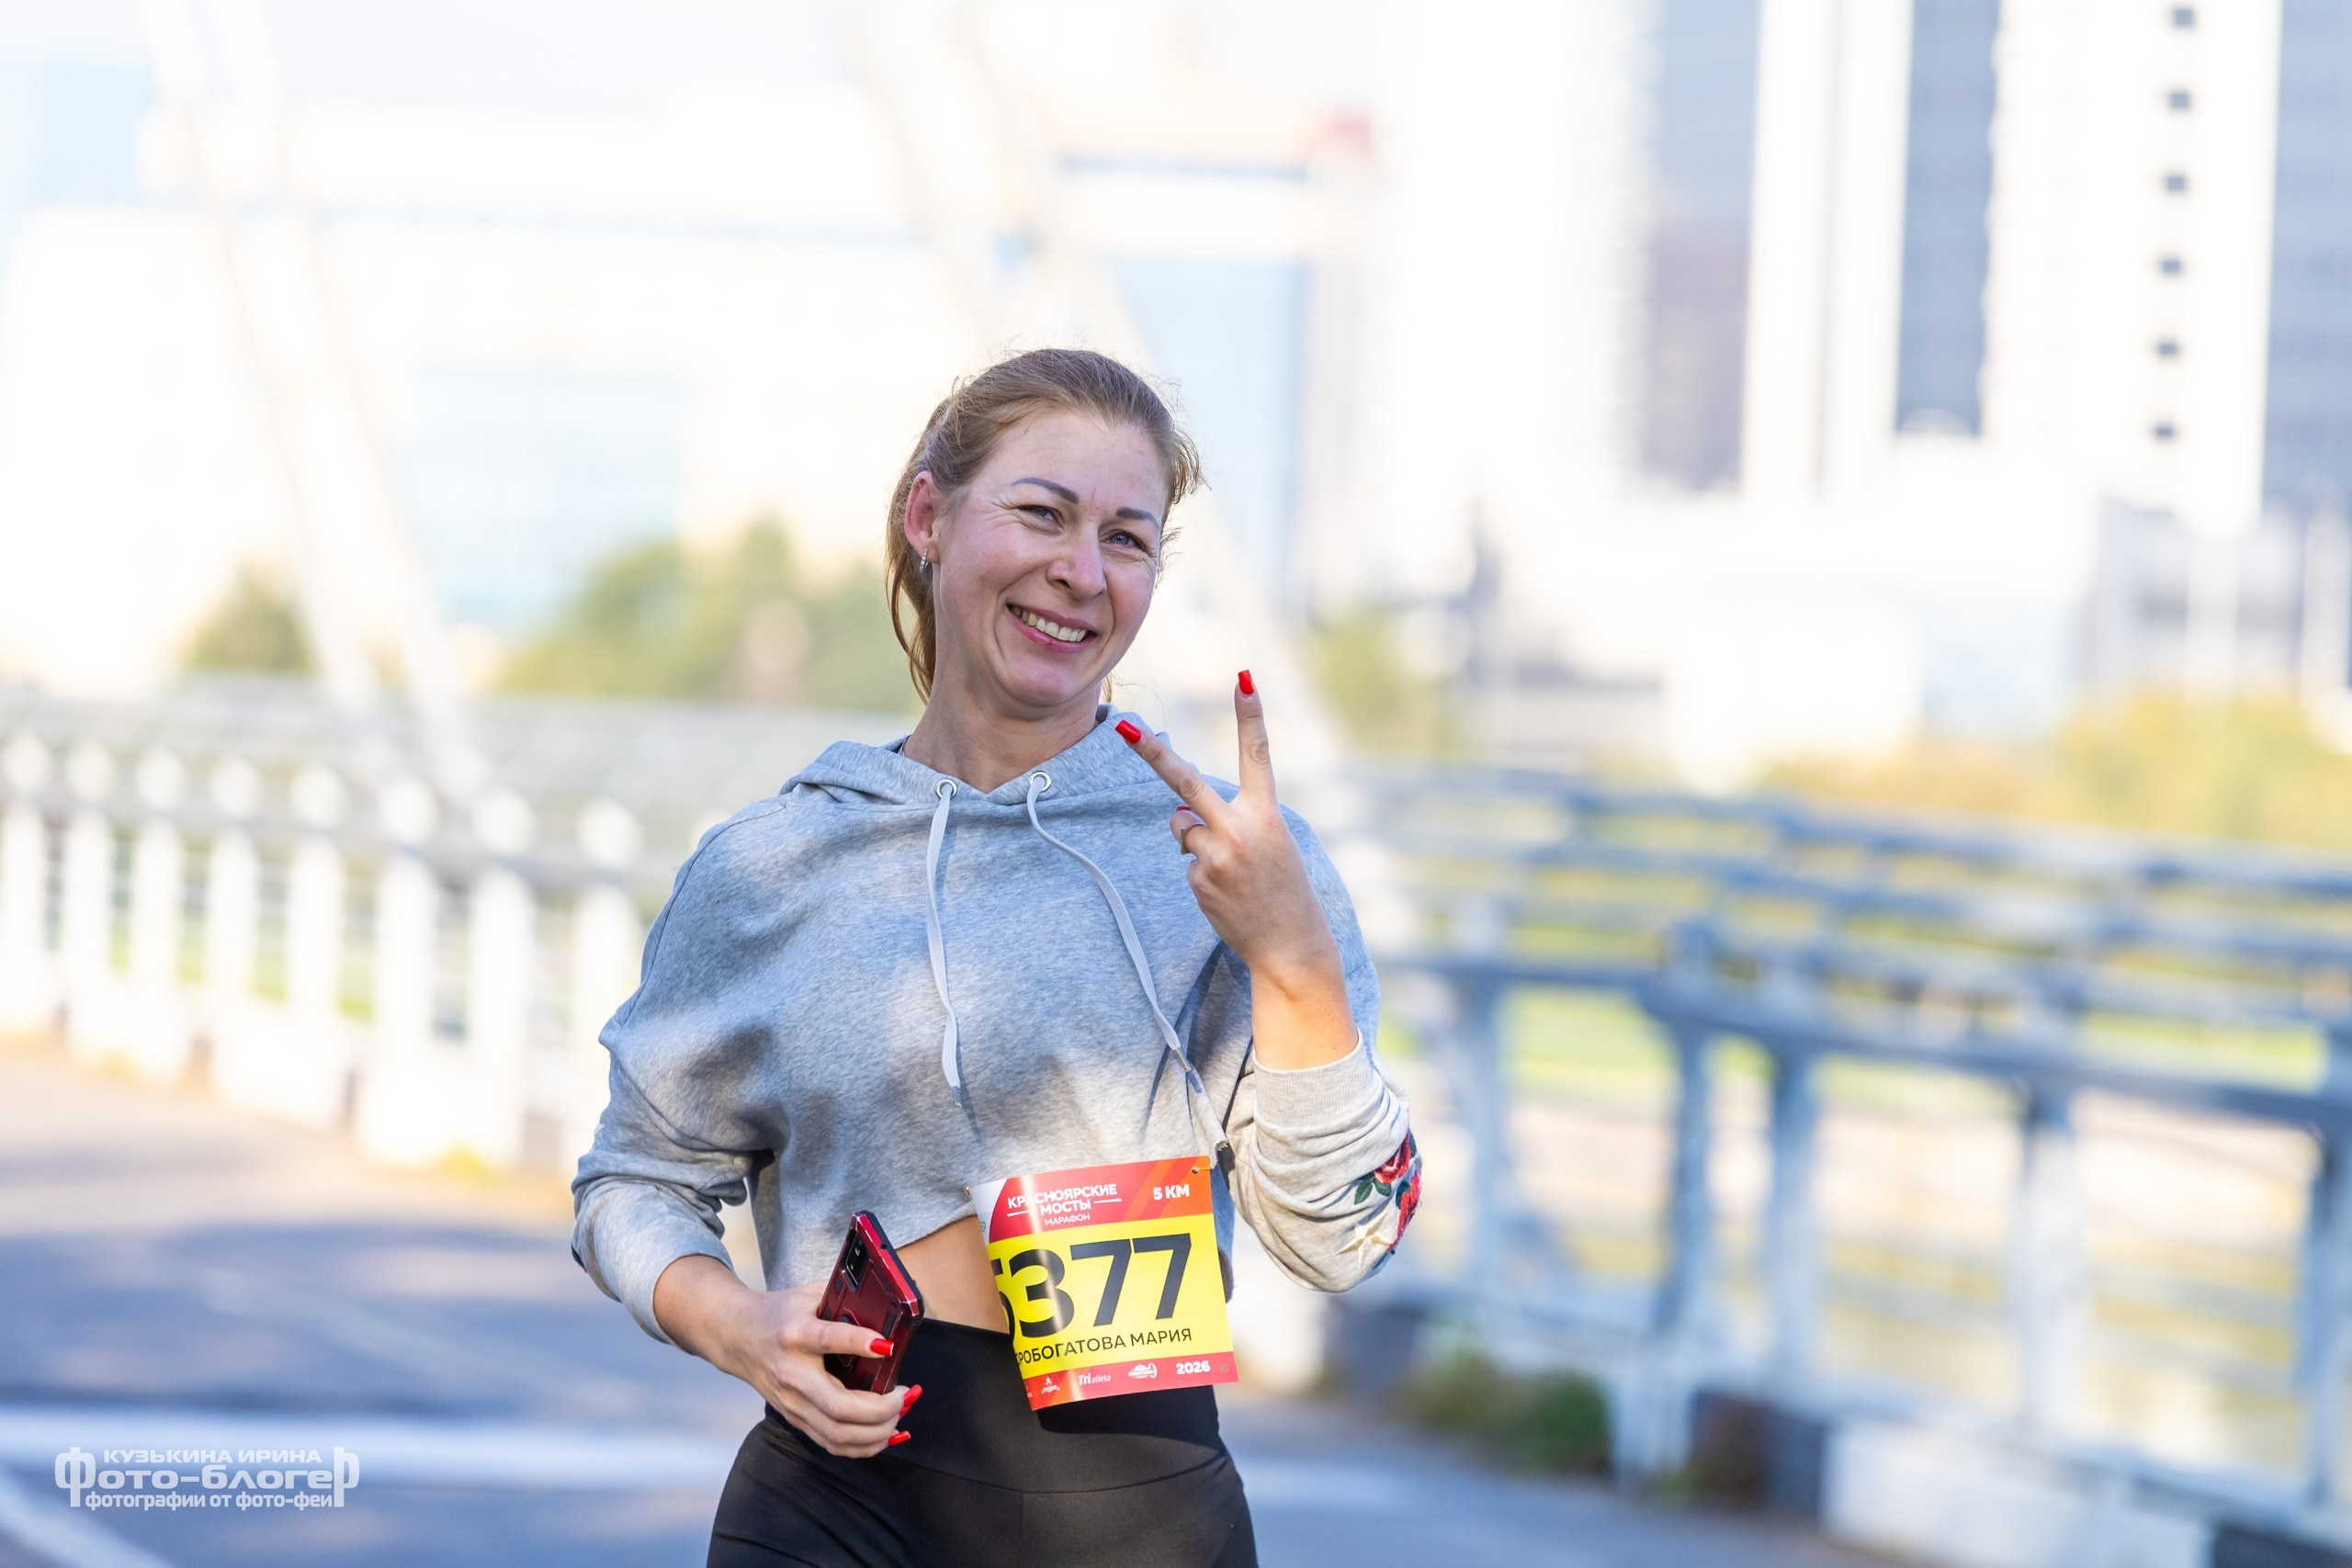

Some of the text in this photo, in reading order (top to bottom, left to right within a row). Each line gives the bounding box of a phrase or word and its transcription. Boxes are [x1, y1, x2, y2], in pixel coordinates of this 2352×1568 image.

[1153, 1186, 1163, 1201] 5
[1040, 1199, 1091, 1215] МОСТЫ
[1044, 1213, 1091, 1226] МАРАФОН
[1015, 1327, 1193, 1366] РОБОГАТОВА МАРИЯ
[1176, 1360, 1211, 1375] 2026
